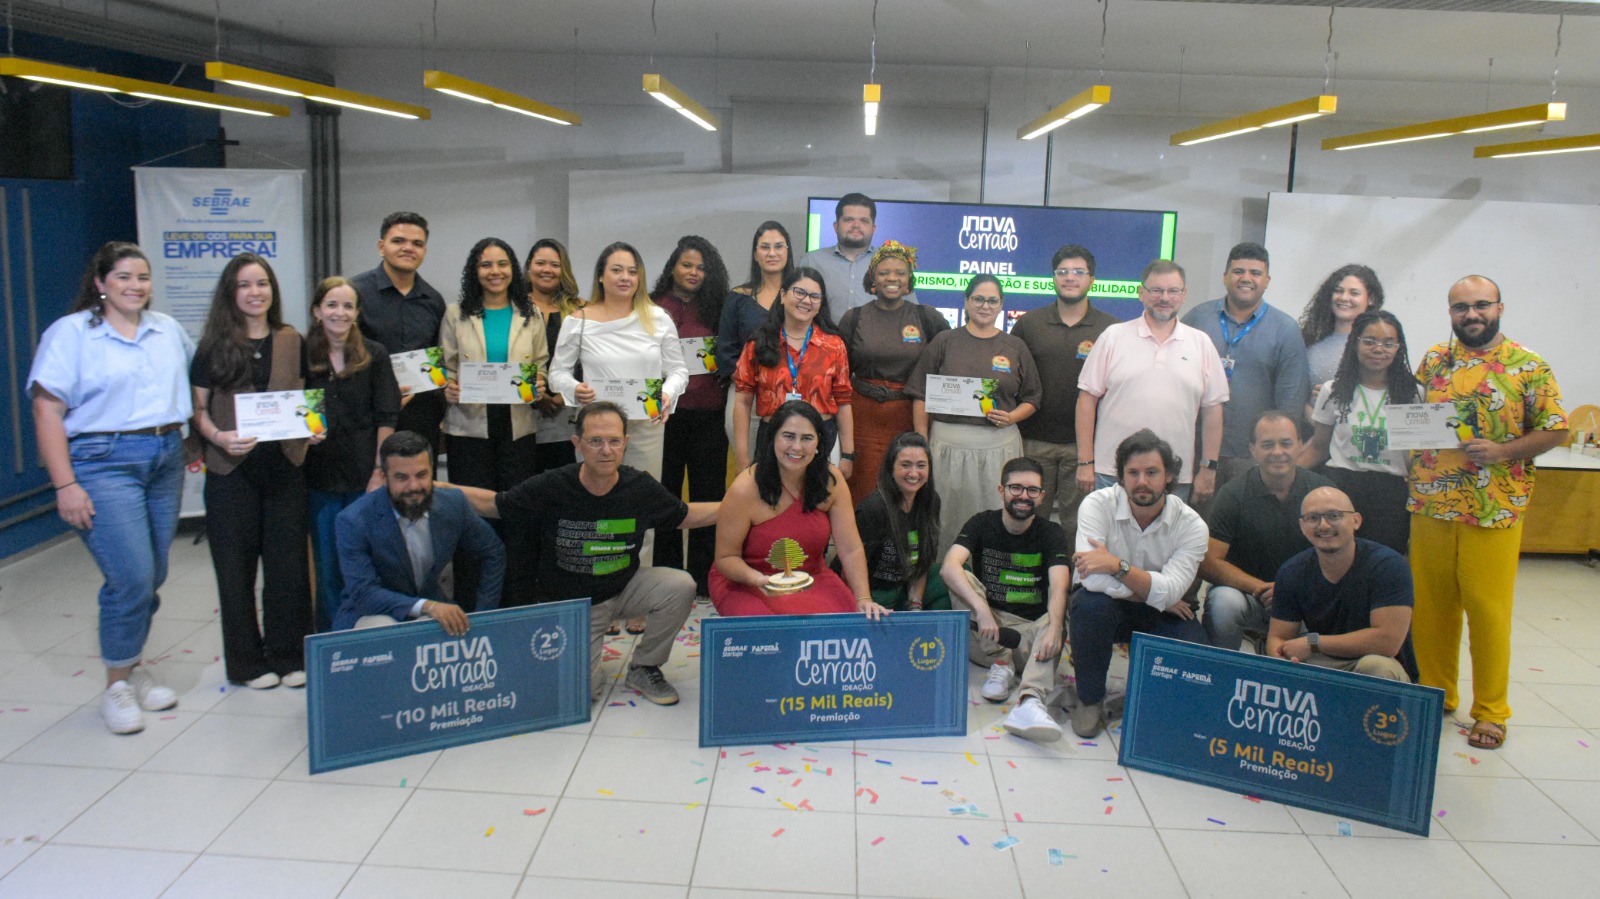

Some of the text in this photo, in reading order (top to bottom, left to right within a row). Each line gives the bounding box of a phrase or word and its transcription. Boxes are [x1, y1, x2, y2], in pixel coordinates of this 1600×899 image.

[192, 197, 251, 207] SEBRAE
[963, 215, 1016, 233] INOVA
[206, 232, 228, 240] ODS
[959, 229, 1018, 252] Cerrado
[164, 241, 277, 259] EMPRESA!
[960, 260, 1016, 275] PAINEL
[1024, 280, 1030, 289] E
[416, 636, 493, 667] INOVA
[801, 638, 873, 660] INOVA
[412, 651, 497, 693] Cerrado
[796, 653, 876, 686] Cerrado
[1152, 664, 1179, 675] SEBRAE
[780, 697, 805, 715] (15
[811, 695, 837, 710] Mil
[843, 692, 893, 710] Reais)
[1235, 678, 1318, 716] INOVA
[396, 691, 517, 729] (10 Mil Reais)
[810, 712, 860, 723] Premiação
[1227, 695, 1320, 744] Cerrado
[430, 715, 483, 731] Premiação
[1209, 737, 1228, 757] (5
[1234, 743, 1265, 764] Mil
[1272, 751, 1334, 782] Reais)
[1239, 760, 1298, 780] Premiação
